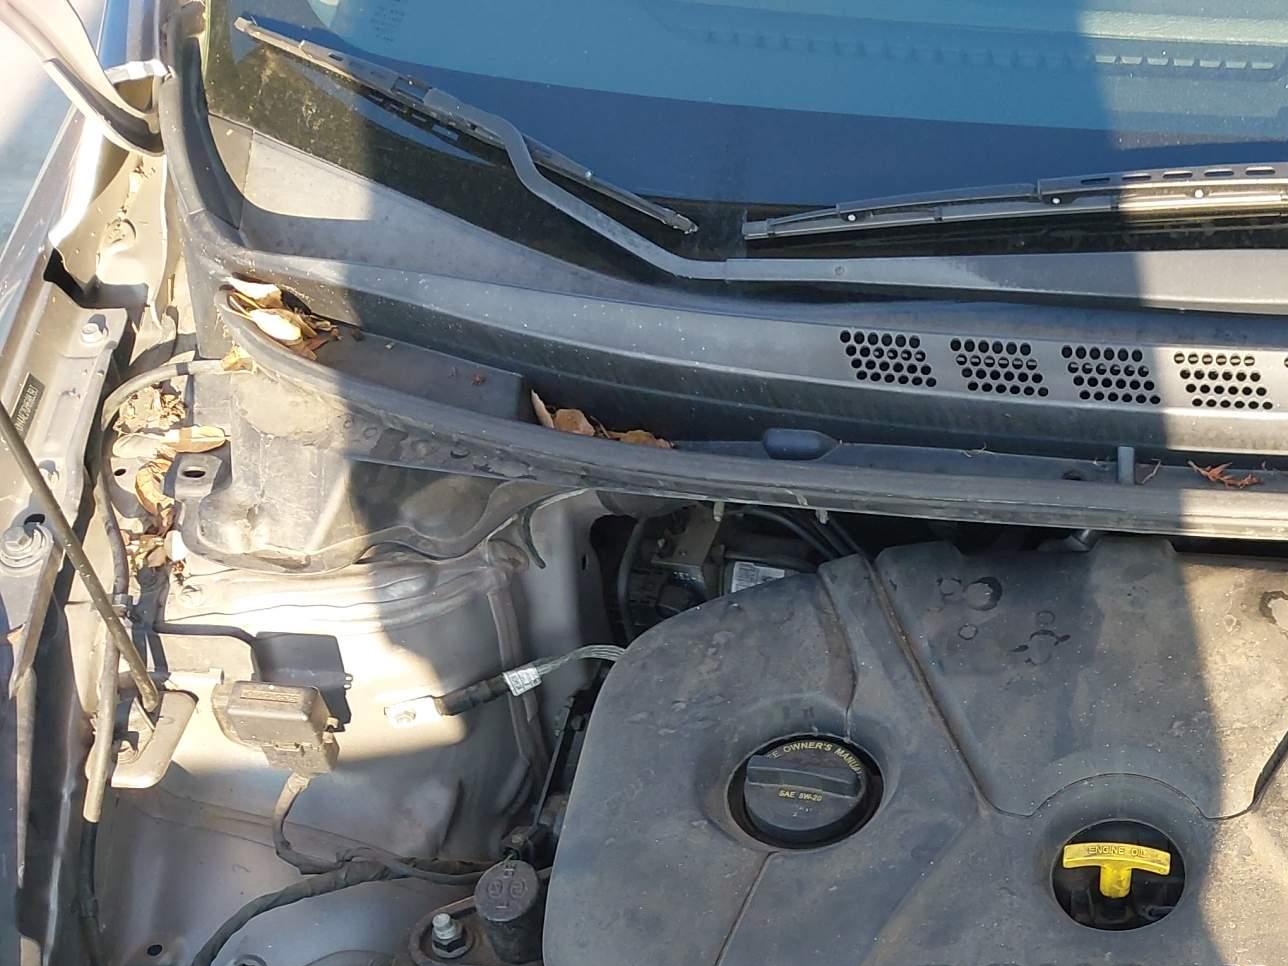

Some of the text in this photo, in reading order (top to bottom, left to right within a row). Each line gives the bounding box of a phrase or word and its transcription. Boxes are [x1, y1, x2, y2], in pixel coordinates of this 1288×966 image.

[783, 741, 832, 752] OWNER'S
[778, 789, 796, 799] SAE
[1088, 845, 1146, 858] ENGINE OIL
